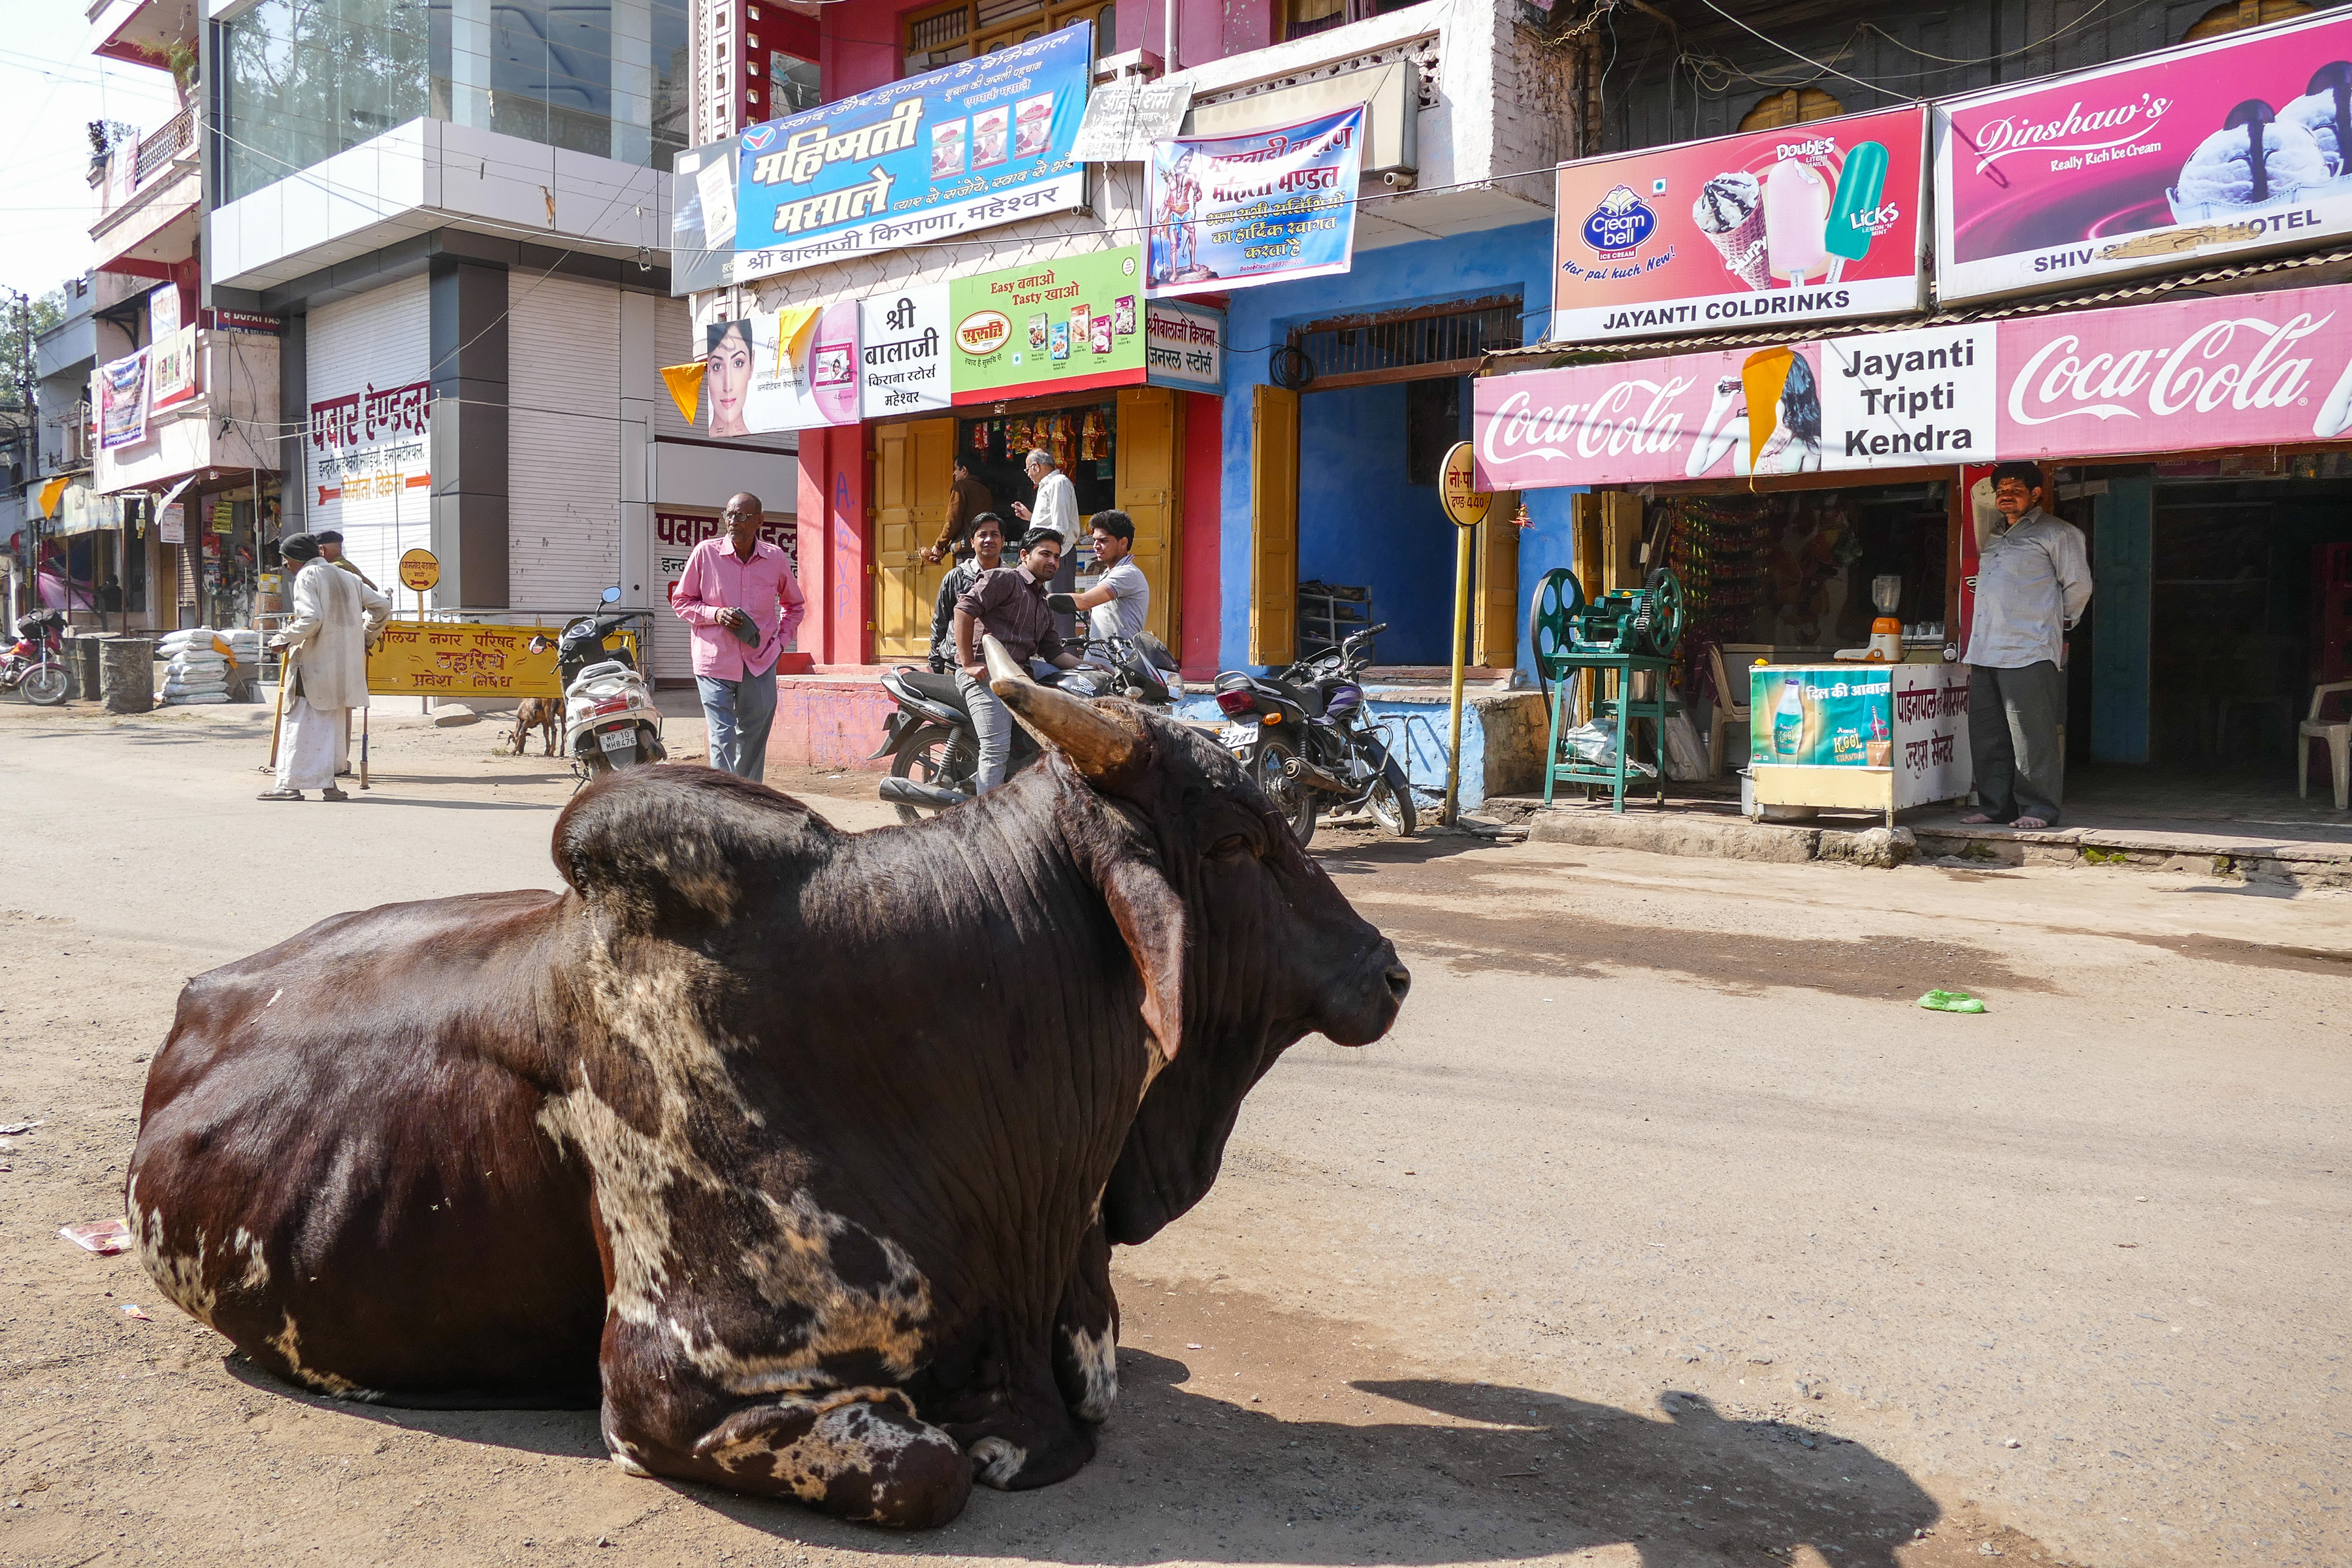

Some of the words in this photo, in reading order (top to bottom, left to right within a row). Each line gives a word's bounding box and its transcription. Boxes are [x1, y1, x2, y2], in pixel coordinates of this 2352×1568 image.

[971, 73, 985, 91] की
[984, 64, 1013, 86] असली
[1013, 61, 1044, 78] पहचान
[1000, 78, 1032, 97] मसाले
[1974, 93, 2174, 155] Dinshaw's
[752, 97, 925, 186] महिष्मती
[1805, 160, 1831, 169] VANILLA
[1806, 155, 1827, 163] LITCHI
[2051, 157, 2083, 172] Really
[2085, 149, 2110, 165] Rich
[2112, 147, 2126, 159] Ice
[2126, 142, 2161, 158] Cream
[925, 187, 941, 204] से
[1032, 159, 1049, 177] से
[772, 165, 896, 235] मसाले
[747, 250, 774, 270] श्री
[780, 230, 862, 263] बालाजी
[968, 186, 1060, 220] महेश्वर
[1212, 230, 1232, 244] का
[1286, 216, 1337, 236] स्वागत
[1592, 214, 1645, 233] Cream
[1604, 227, 1635, 246] bell
[1862, 225, 1884, 233] LEMON
[1245, 242, 1287, 259] करता
[1287, 238, 1301, 257] है
[1612, 250, 1635, 259] CREAM
[2034, 248, 2093, 272] SHIV
[1562, 260, 1584, 276] Har
[1584, 268, 1609, 282] pal
[1611, 264, 1641, 279] kuch
[1646, 245, 1676, 271] New!
[990, 281, 1015, 295] Easy
[1017, 269, 1056, 289] बनाओ
[1012, 290, 1042, 306] Tasty
[1044, 281, 1080, 301] खाओ
[886, 298, 916, 331] श्री
[1603, 305, 1697, 329] JAYANTI
[1705, 290, 1850, 319] COLDRINKS
[864, 327, 939, 366] बालाजी
[1842, 338, 1974, 381] Jayanti
[964, 357, 976, 367] स्वाद
[1149, 346, 1182, 370] जनरल
[1186, 350, 1213, 374] स्टोर्स
[2008, 310, 2336, 425] Coca-Cola
[868, 372, 905, 387] किराना
[907, 364, 936, 381] स्टोर्स
[885, 391, 919, 406] महेश्वर
[1860, 382, 1954, 419] Tripti
[311, 393, 359, 451] पवार
[1483, 374, 1699, 465] Coca-Cola
[1845, 424, 1972, 457] Kendra
[428, 632, 463, 646] नगर
[472, 629, 517, 650] परिषद
[436, 648, 508, 676] ठहरिये
[411, 669, 455, 687] प्रवेश
[470, 672, 514, 688] निषेध
[1070, 685, 1094, 696] HONDA
[1805, 685, 1829, 700] दिल
[1831, 683, 1848, 699] की
[606, 736, 636, 750] MH8476
[1833, 733, 1863, 754] KOOL
[1834, 751, 1866, 762] THANDAI
